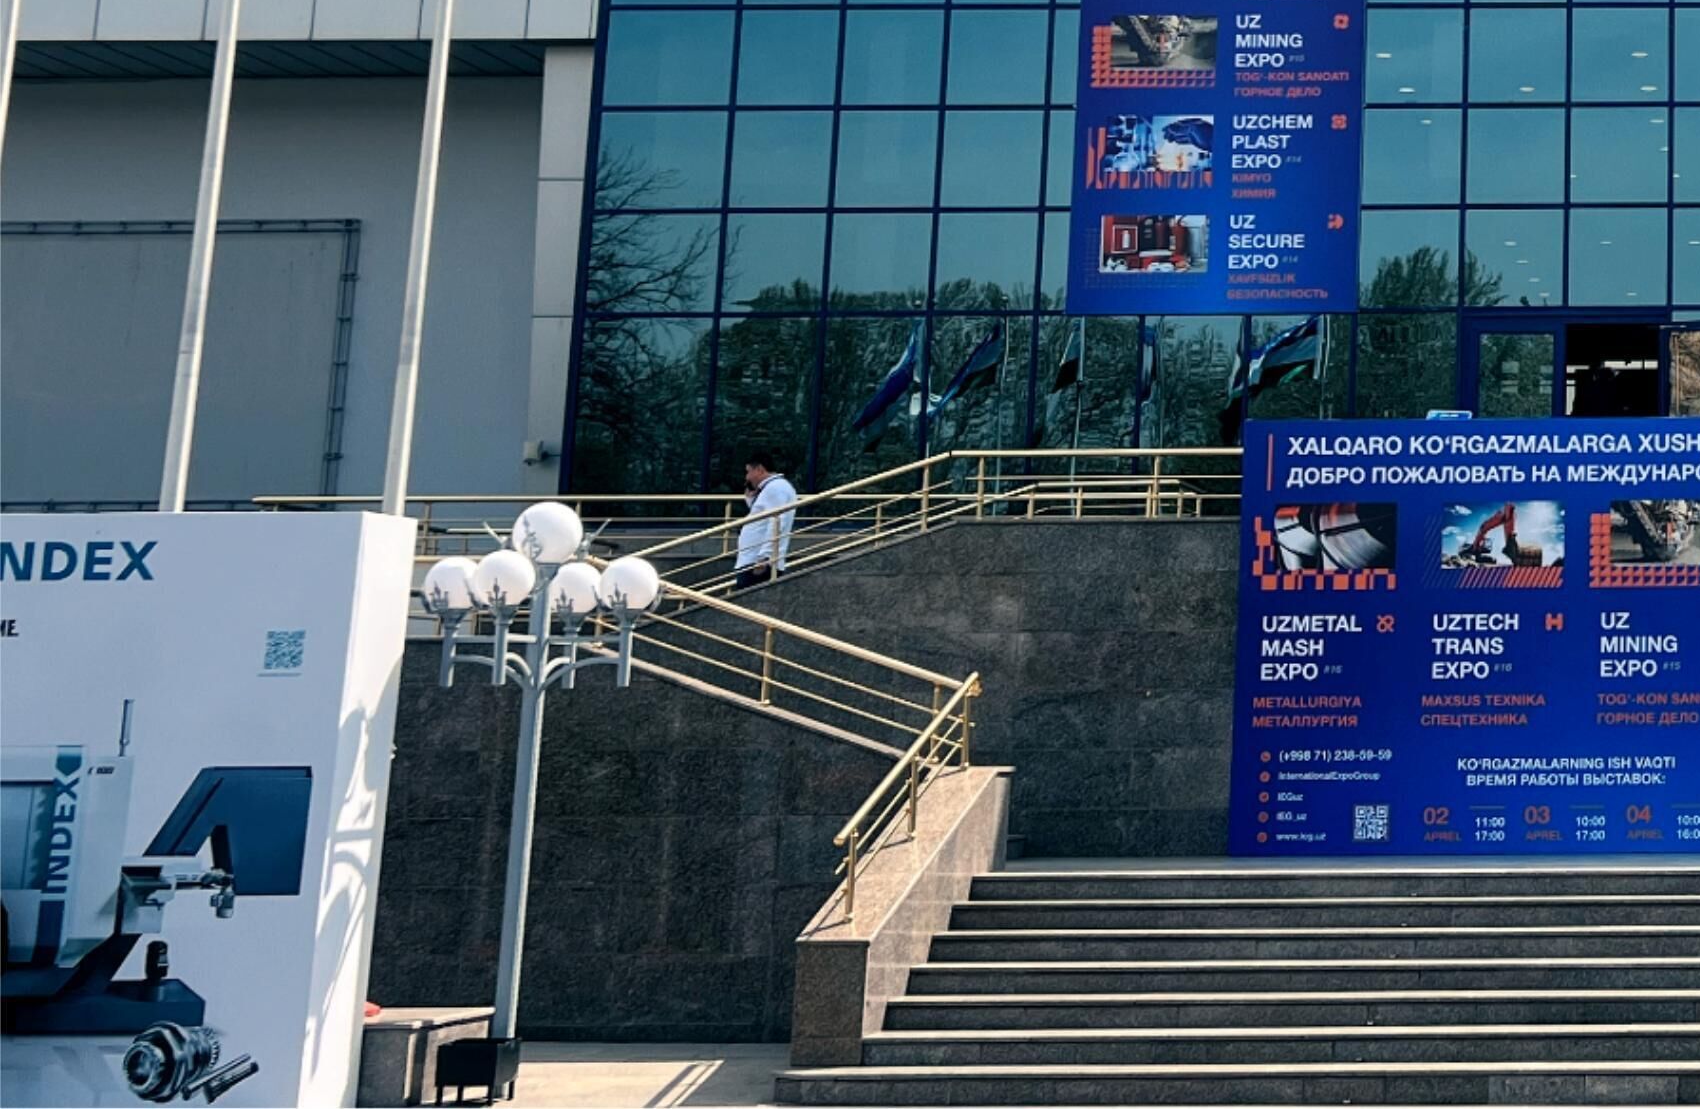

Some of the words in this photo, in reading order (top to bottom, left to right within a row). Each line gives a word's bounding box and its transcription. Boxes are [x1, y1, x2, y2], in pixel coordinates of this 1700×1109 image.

[1235, 15, 1262, 29] UZ
[1235, 34, 1303, 48] MINING
[1234, 53, 1284, 68] EXPO
[1232, 114, 1313, 129] UZCHEM
[1232, 135, 1291, 149] PLAST
[1231, 154, 1282, 169] EXPO
[1232, 172, 1272, 183] KIMYO
[1229, 214, 1256, 230] UZ
[1228, 234, 1305, 249] SECURE
[1227, 254, 1279, 269] EXPO
[1287, 435, 1402, 456] XALQARO
[1286, 466, 1367, 489] ДОБРО
[1371, 465, 1526, 486] ПОЖАЛОВАТЬ
[1531, 464, 1562, 485] НА
[1261, 614, 1363, 633] UZMETAL
[1432, 613, 1520, 631] UZTECH
[1600, 611, 1630, 631] UZ
[1261, 638, 1325, 657] MASH
[1431, 637, 1504, 655] TRANS
[1599, 635, 1679, 654] MINING
[1260, 663, 1319, 681] EXPO
[1431, 661, 1490, 680] EXPO
[1599, 659, 1658, 678] EXPO
[1252, 695, 1362, 709] METALLURGIYA
[1421, 694, 1481, 707] MAXSUS
[1484, 693, 1546, 707] TEXNIKA
[1252, 714, 1358, 728] МЕТАЛЛУРГИЯ
[1420, 713, 1528, 728] СПЕЦТЕХНИКА
[1596, 711, 1658, 725] ГОРНОЕ
[1658, 711, 1700, 726] ДЕЛО
[1278, 749, 1312, 763] (+998
[1607, 756, 1632, 770] ISH
[1635, 756, 1676, 770] VAQTI
[1466, 773, 1517, 787] ВРЕМЯ
[1520, 773, 1579, 786] РАБОТЫ
[1583, 772, 1666, 786] ВЫСТАВОК:
[1423, 806, 1449, 825] 02
[1524, 805, 1551, 824] 03
[1576, 816, 1606, 827] 10:00
[1626, 805, 1652, 823] 04
[1475, 816, 1505, 828] 11:00
[40, 776, 81, 894] INDEX
[1475, 830, 1505, 841] 17:00
[1576, 829, 1606, 841] 17:00
